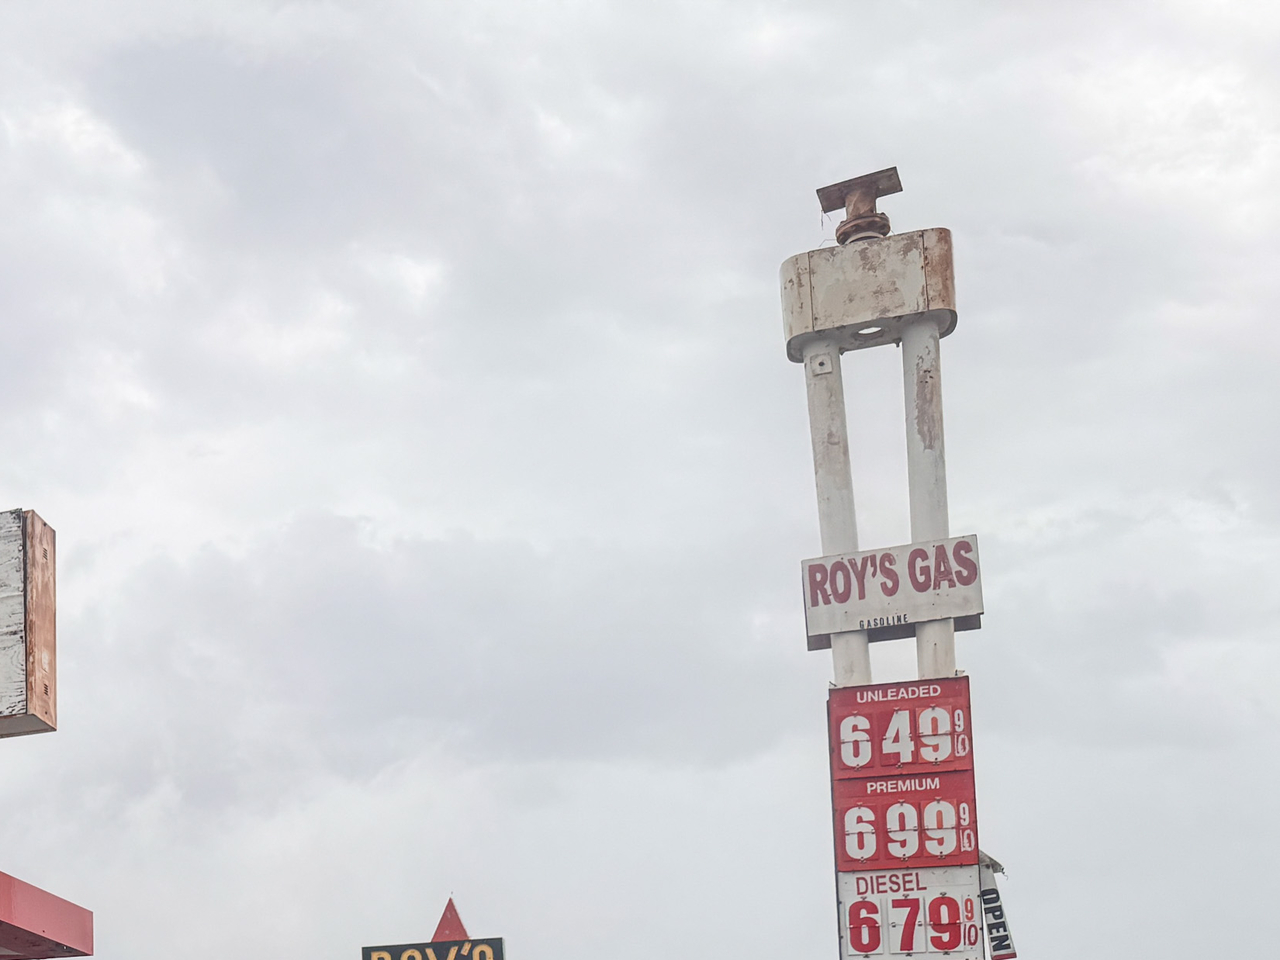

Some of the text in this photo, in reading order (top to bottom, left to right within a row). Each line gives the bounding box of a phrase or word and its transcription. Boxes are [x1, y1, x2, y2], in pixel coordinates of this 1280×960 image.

[808, 540, 978, 607] ROY'S GAS
[859, 613, 909, 630] GASOLINE
[856, 684, 942, 704] UNLEADED
[866, 777, 941, 794] PREMIUM
[856, 872, 928, 896] DIESEL
[980, 887, 1012, 951] OPEN
